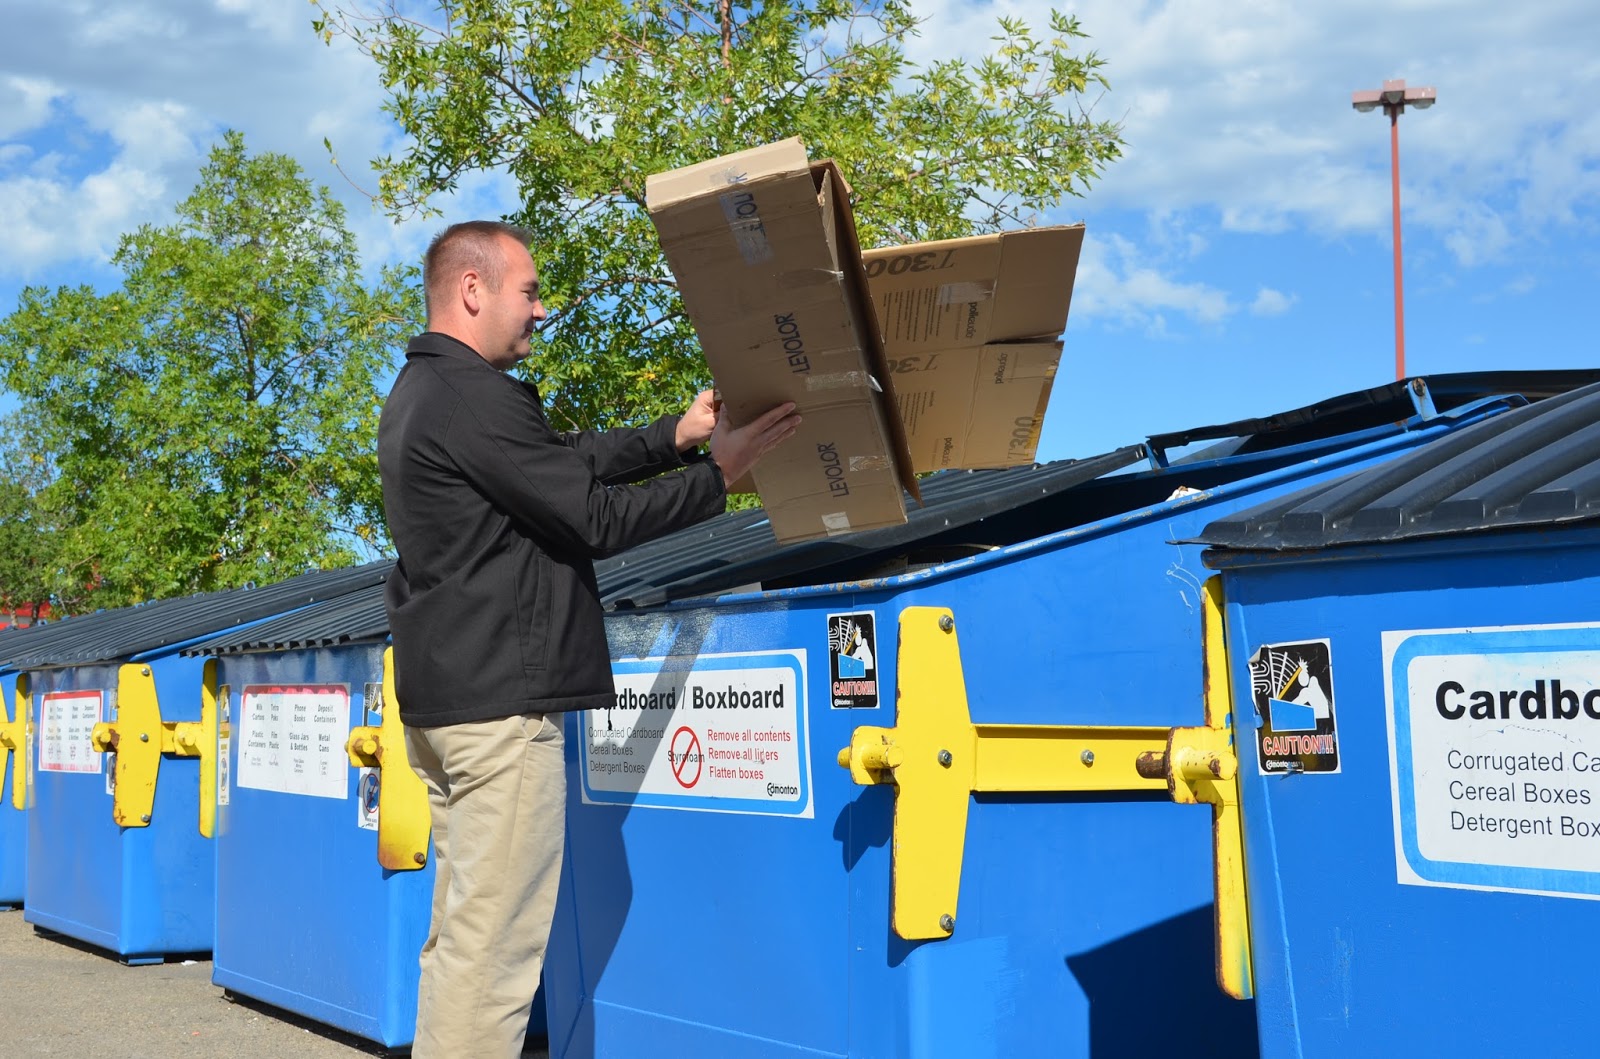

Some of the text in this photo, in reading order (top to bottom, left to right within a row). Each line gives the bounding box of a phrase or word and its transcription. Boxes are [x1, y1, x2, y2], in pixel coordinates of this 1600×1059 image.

[866, 249, 958, 279] T300
[775, 312, 811, 375] LEVOLOR
[887, 354, 940, 374] T3
[1007, 416, 1033, 460] T300
[817, 442, 849, 498] LEVOLOR
[595, 687, 676, 710] rdboard
[692, 684, 785, 710] Boxboard
[1435, 679, 1600, 720] Cardbo
[318, 704, 333, 712] Deposit
[294, 714, 305, 722] Books
[314, 715, 336, 723] Containers
[318, 733, 330, 741] Metal
[589, 727, 664, 740] Corrugated Cardboard
[707, 729, 791, 742] Remove all contents
[319, 744, 329, 752] Cans
[589, 743, 633, 756] Cereal Boxes
[708, 747, 740, 760] Remove
[743, 748, 752, 760] all
[667, 750, 705, 765] Styrofoam
[1447, 750, 1563, 776] Corrugated
[590, 761, 645, 775] Detergent Boxes
[709, 766, 764, 780] Flatten boxes
[767, 782, 798, 796] Edmonton
[1449, 781, 1591, 805] Cereal Boxes
[1450, 811, 1552, 838] Detergent
